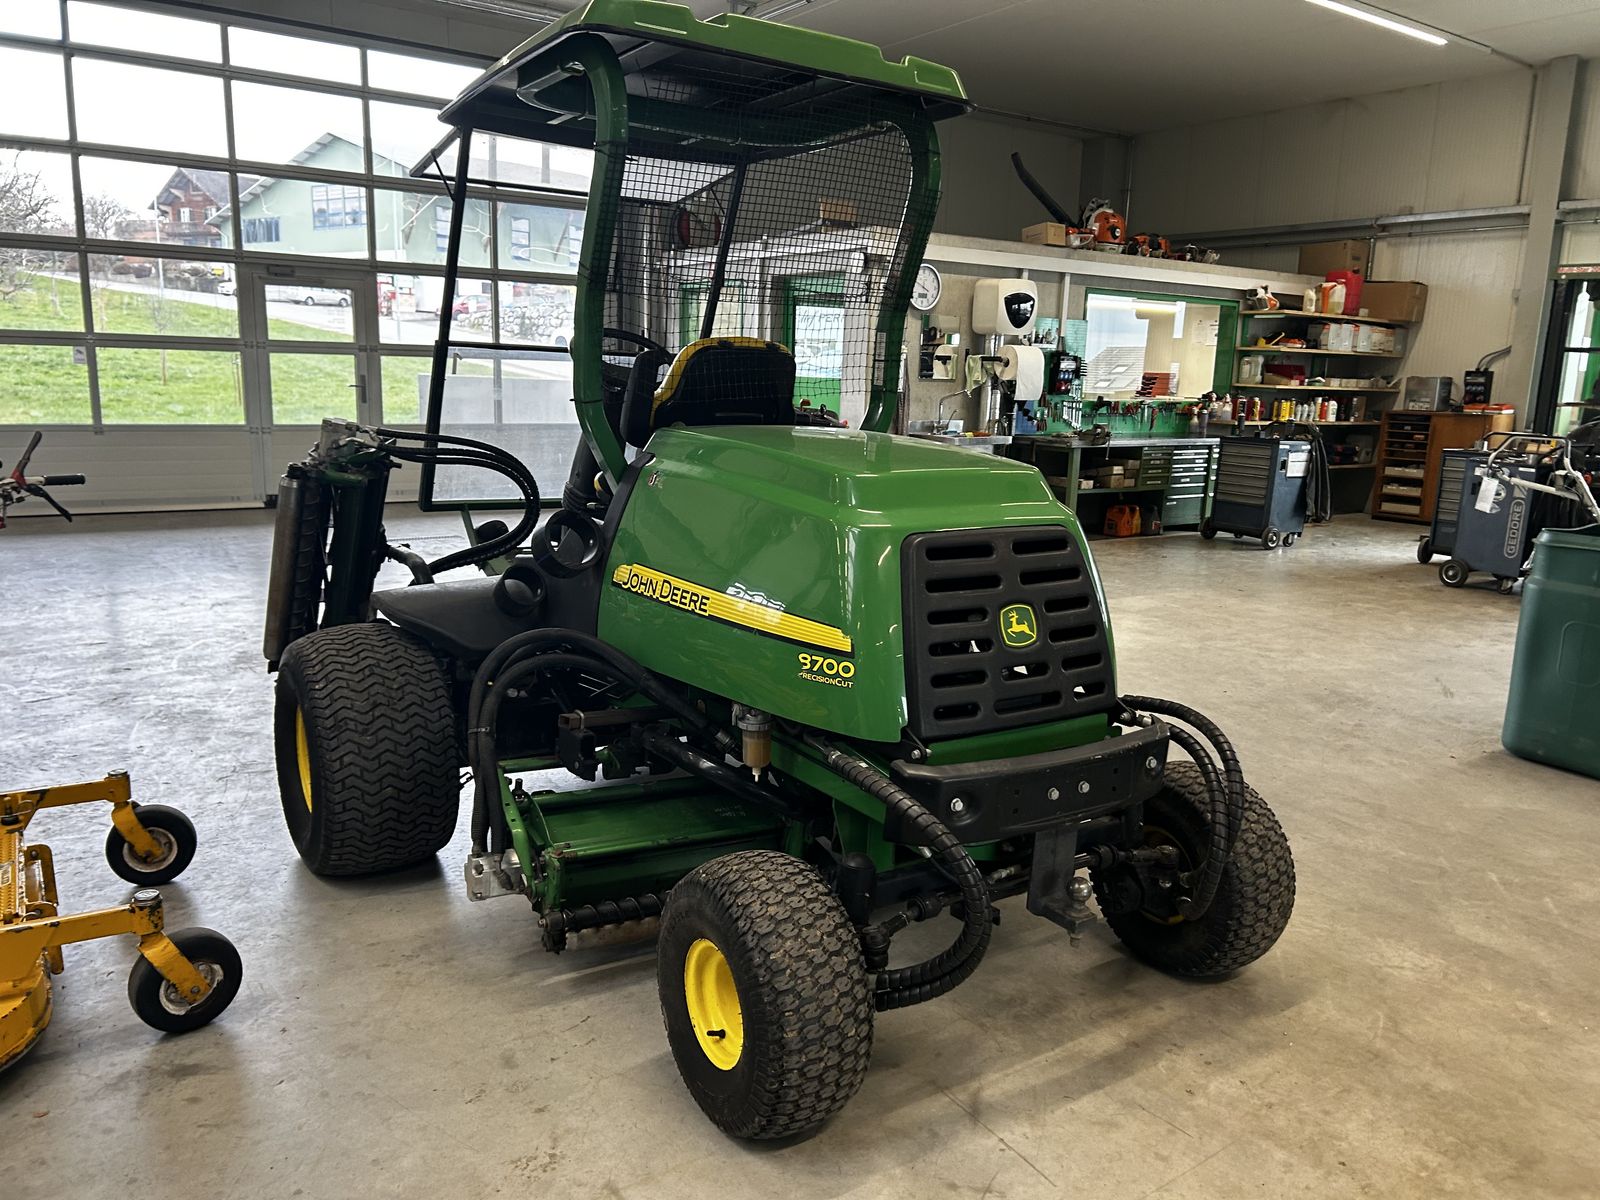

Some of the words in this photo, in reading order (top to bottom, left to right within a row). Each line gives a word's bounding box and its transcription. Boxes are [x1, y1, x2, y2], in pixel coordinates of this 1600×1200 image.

[1506, 502, 1522, 554] GEDORE
[622, 568, 659, 596] JOHN
[659, 578, 711, 613] DEERE
